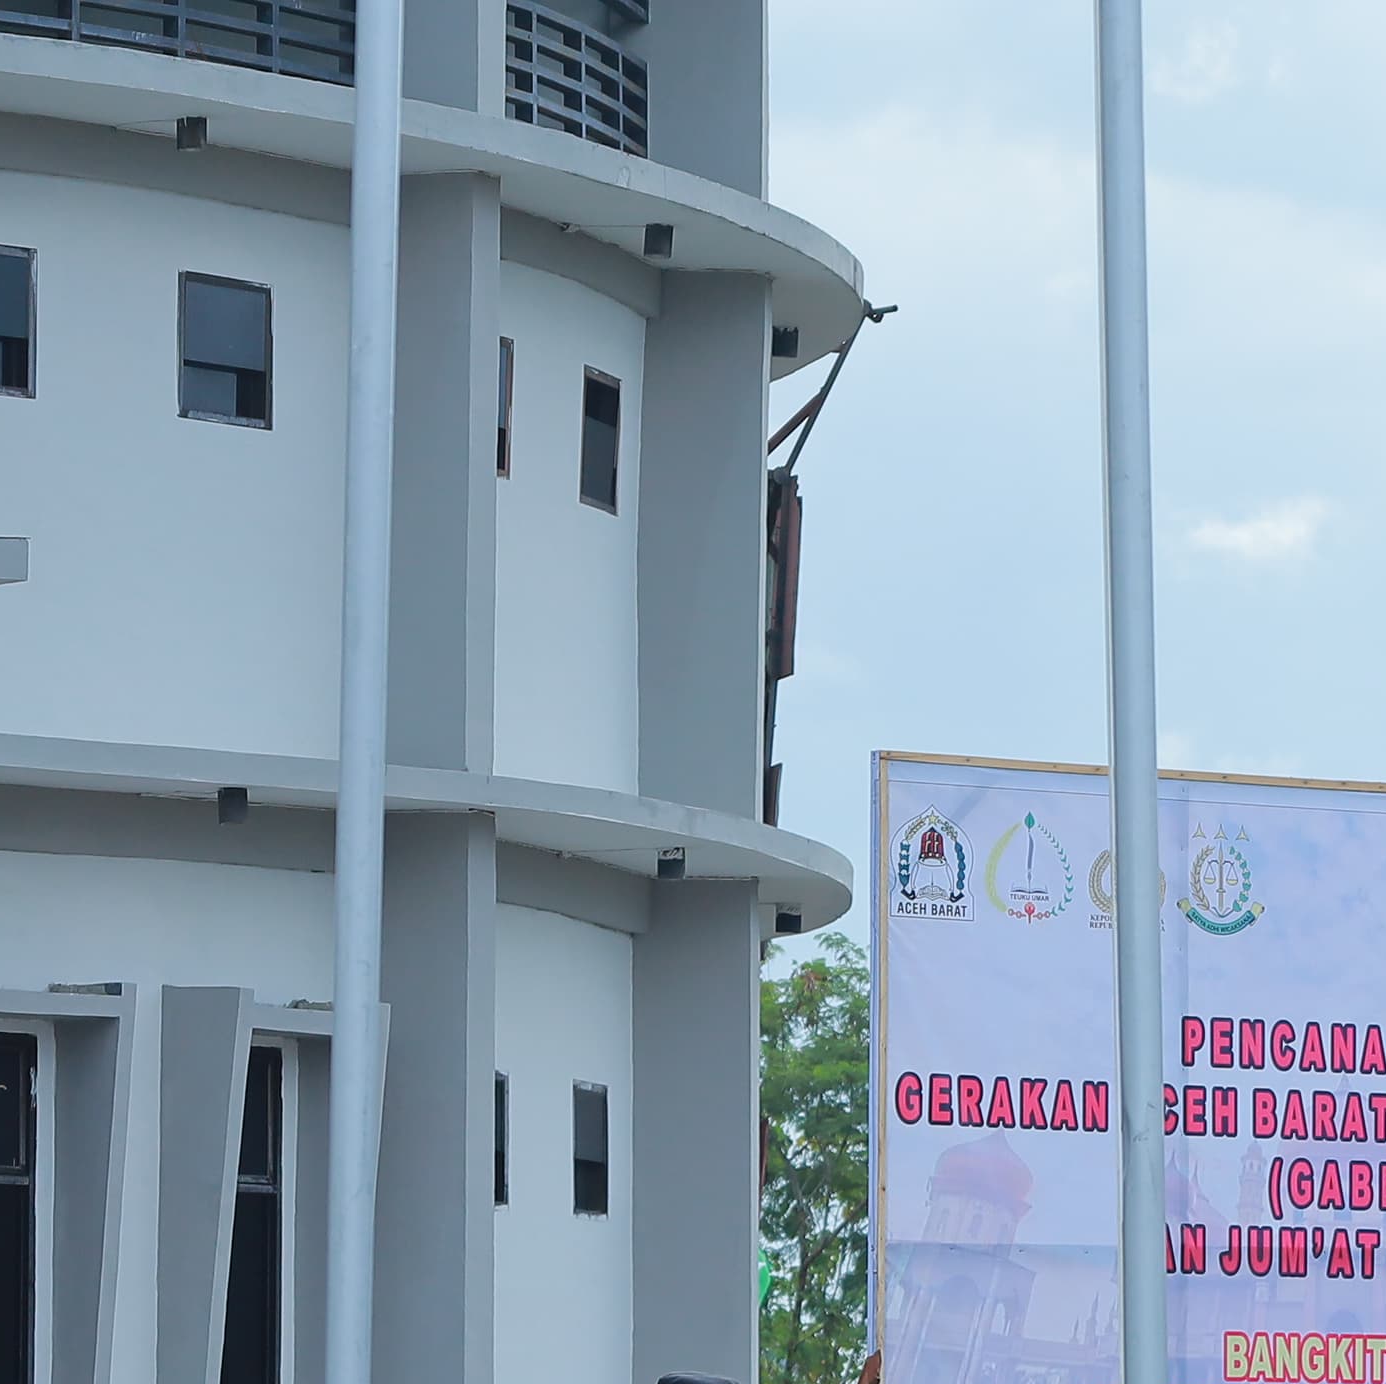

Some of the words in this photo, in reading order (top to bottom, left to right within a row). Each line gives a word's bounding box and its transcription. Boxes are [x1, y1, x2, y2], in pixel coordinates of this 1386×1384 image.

[897, 902, 927, 914] ACEH
[931, 904, 967, 917] BARAT
[895, 1072, 1109, 1132] GERAKAN
[1163, 1084, 1237, 1137] CEH
